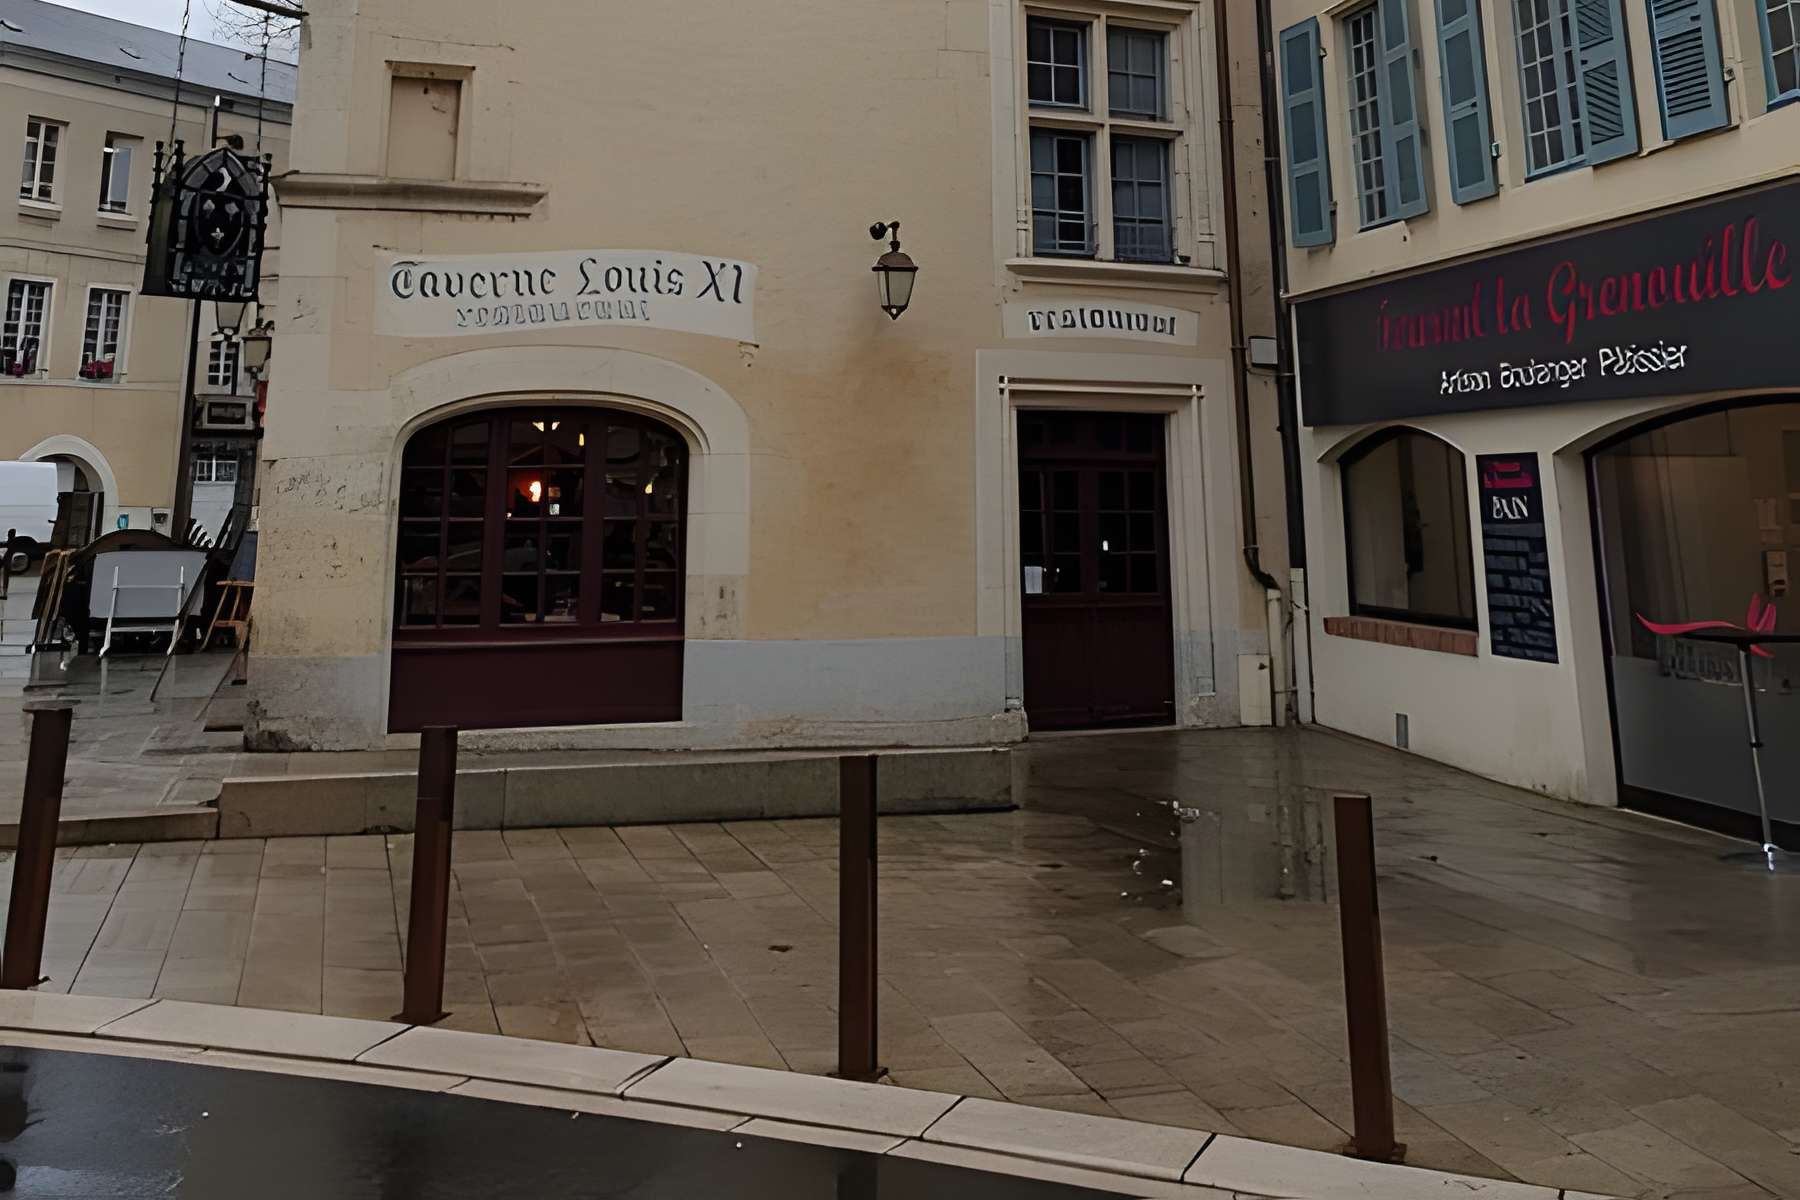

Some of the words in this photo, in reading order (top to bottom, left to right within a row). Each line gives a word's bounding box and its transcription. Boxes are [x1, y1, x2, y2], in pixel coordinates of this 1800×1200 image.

[391, 260, 557, 299] Taverne
[576, 257, 683, 297] Louis
[697, 260, 744, 305] XI
[1547, 216, 1792, 344] Grenouille
